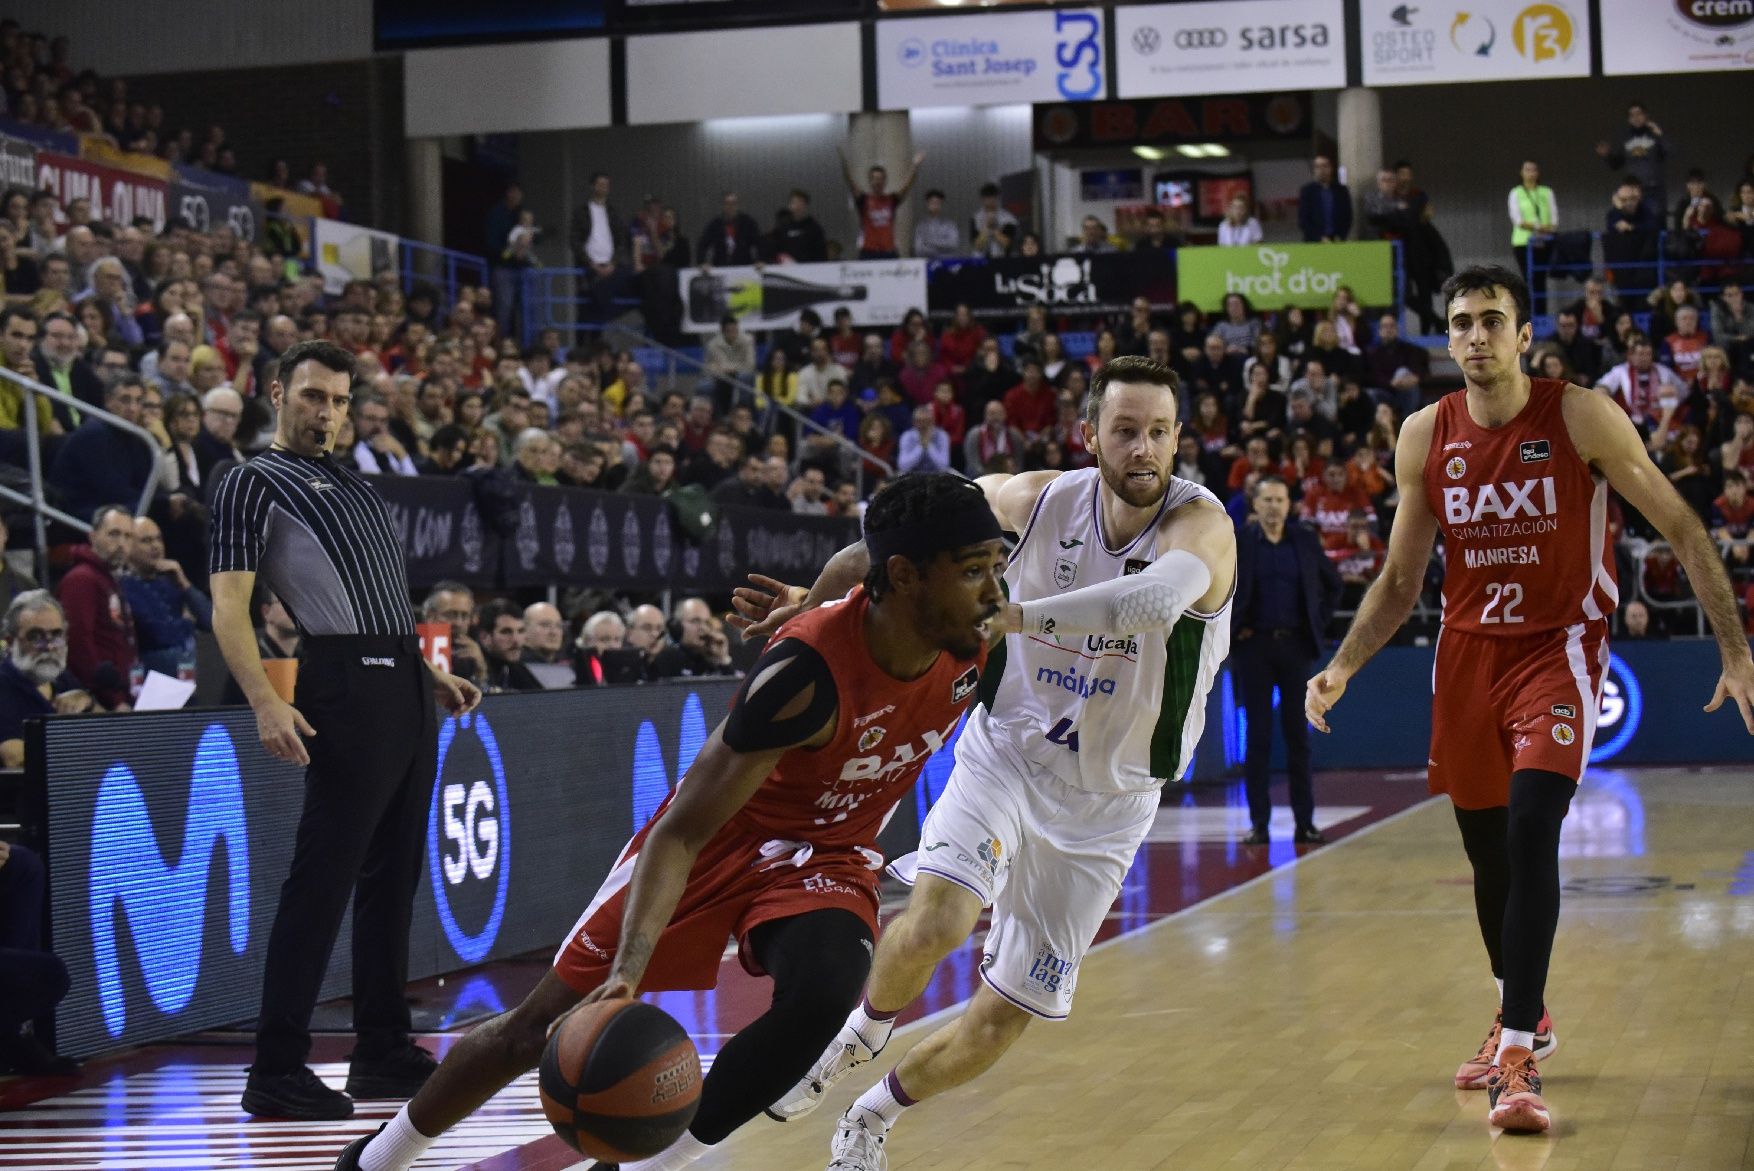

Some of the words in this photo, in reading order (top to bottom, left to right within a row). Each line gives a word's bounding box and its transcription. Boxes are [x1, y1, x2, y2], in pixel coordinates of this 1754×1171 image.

[1239, 24, 1329, 51] sarsa
[1373, 30, 1436, 46] OSTEO
[931, 59, 977, 77] Sant
[984, 58, 1037, 76] Josep
[1055, 12, 1101, 101] CSJ
[1374, 47, 1435, 65] SPORT
[1090, 99, 1251, 140] BAR
[1226, 266, 1283, 295] brot
[1288, 267, 1344, 294] d'or
[1442, 476, 1557, 525] BAXI
[1451, 517, 1558, 541] CLIMATIZACIÓN
[1464, 545, 1541, 569] MANRESA
[1480, 582, 1525, 624] 22
[361, 657, 395, 668] SPALDING
[443, 780, 499, 884] 5G
